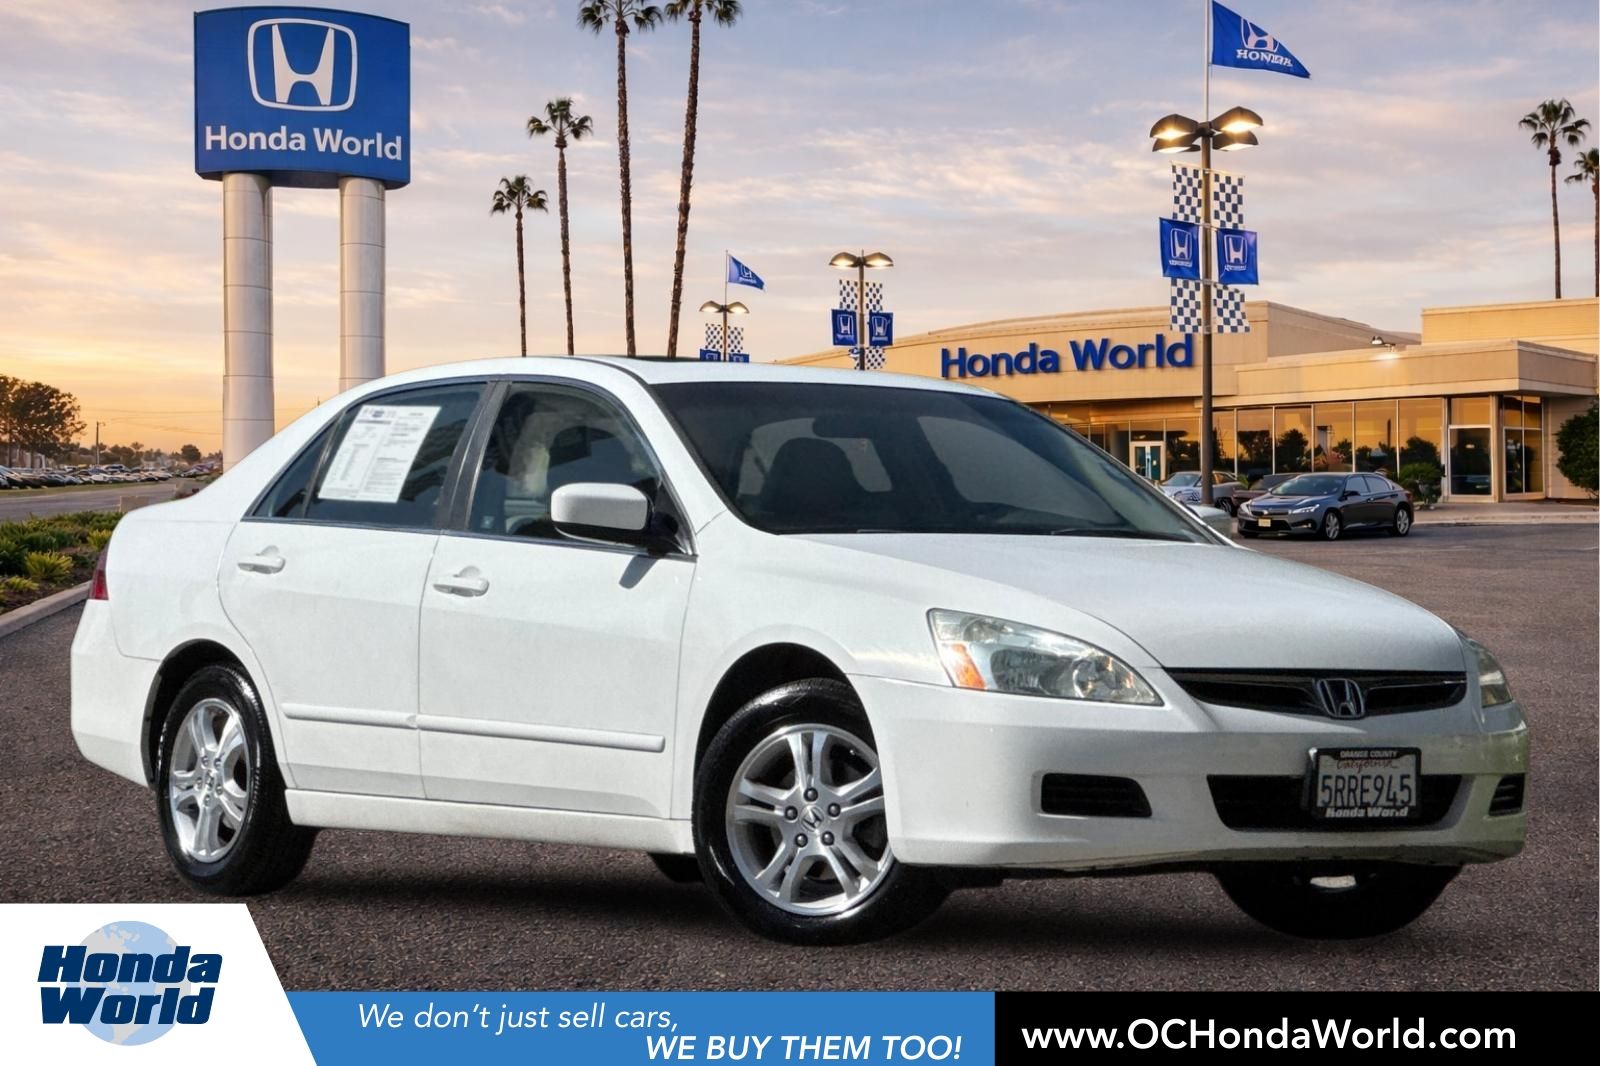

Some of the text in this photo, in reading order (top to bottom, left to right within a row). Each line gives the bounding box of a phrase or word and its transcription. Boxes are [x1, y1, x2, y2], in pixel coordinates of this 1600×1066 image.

[205, 126, 402, 160] Honda World
[941, 333, 1194, 378] Honda World
[1321, 774, 1412, 807] 5RRE945
[1325, 807, 1365, 818] Honda
